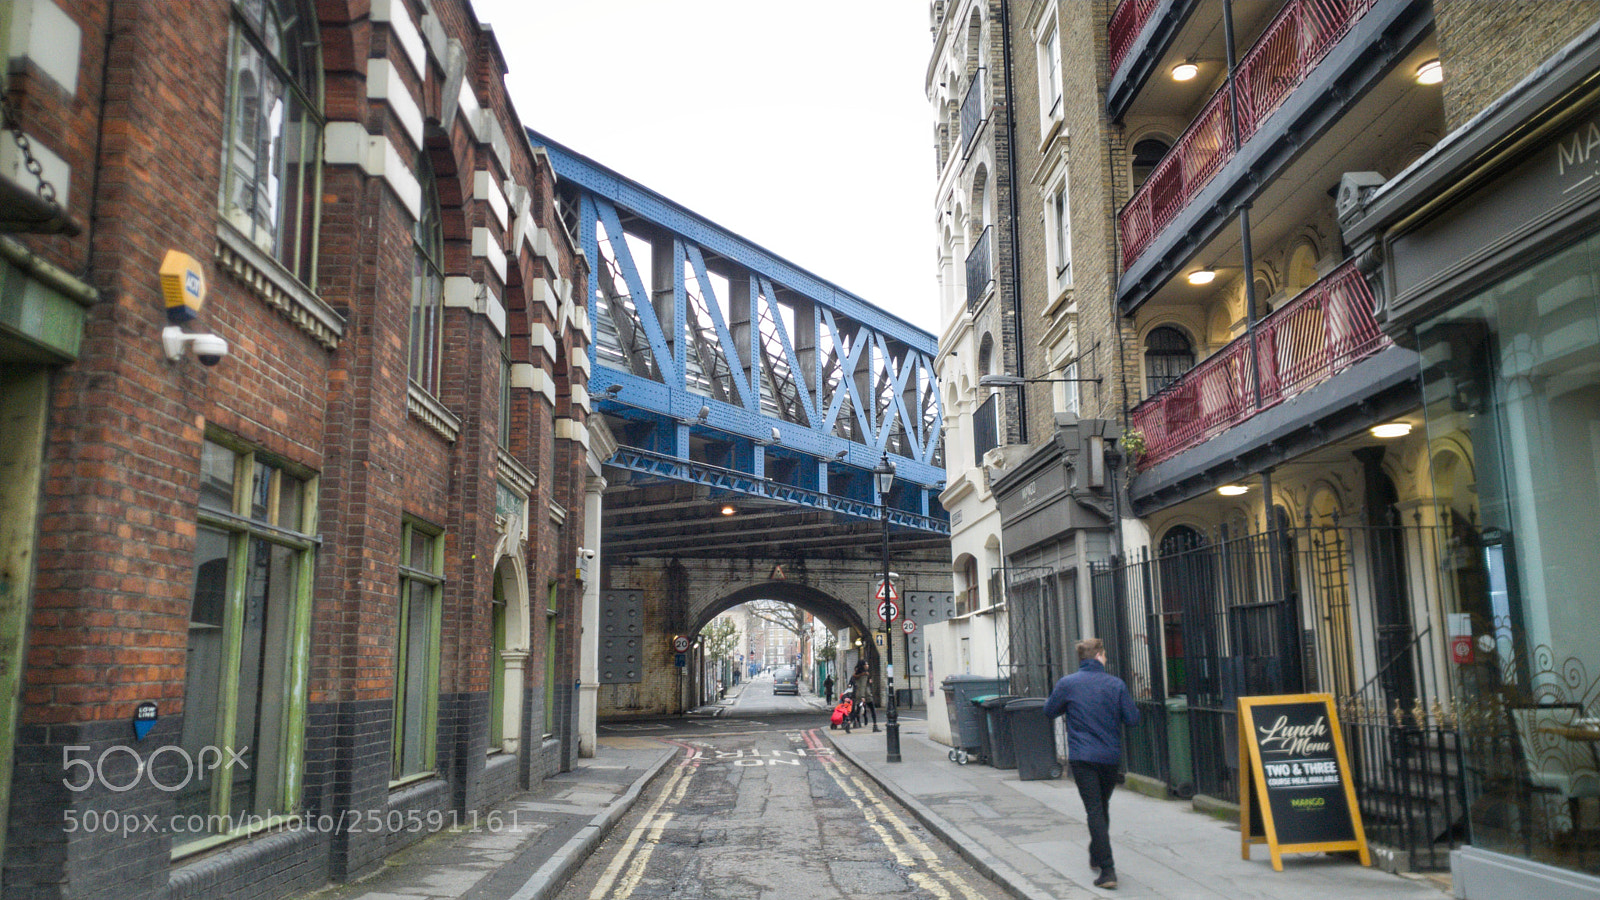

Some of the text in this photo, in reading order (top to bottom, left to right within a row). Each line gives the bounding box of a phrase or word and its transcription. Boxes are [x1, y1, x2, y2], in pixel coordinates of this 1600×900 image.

[881, 606, 897, 616] 20
[676, 640, 688, 648] 20
[1260, 715, 1327, 746] Lunch
[1281, 736, 1330, 756] Menu
[1265, 761, 1337, 777] TWO & THREE
[1268, 774, 1340, 787] COURSE MEAL AVAILABLE
[1291, 798, 1325, 807] MANGO
